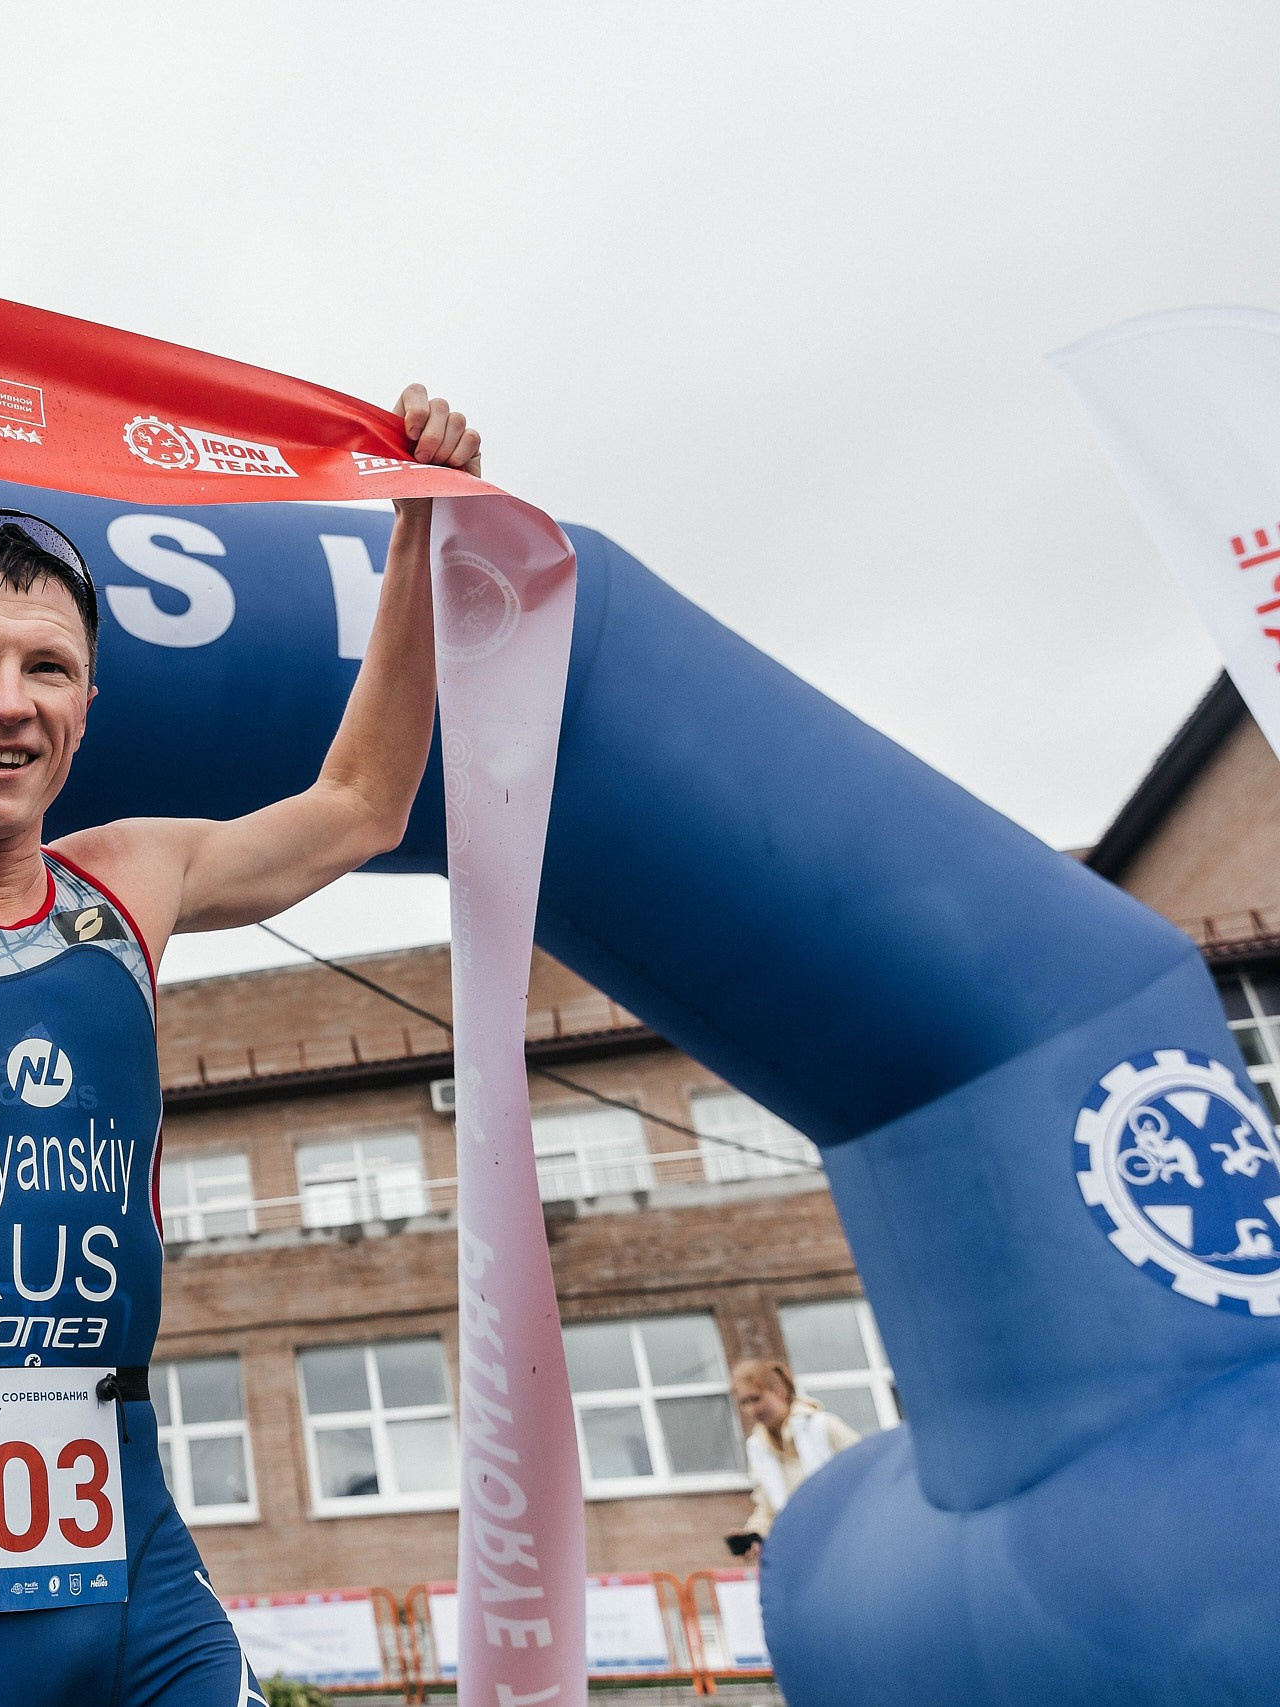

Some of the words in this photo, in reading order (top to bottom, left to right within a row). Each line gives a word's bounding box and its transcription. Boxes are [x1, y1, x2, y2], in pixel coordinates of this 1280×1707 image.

[201, 437, 271, 462] IRON
[216, 457, 289, 475] TEAM
[1, 1391, 89, 1403] СОРЕВНОВАНИЯ
